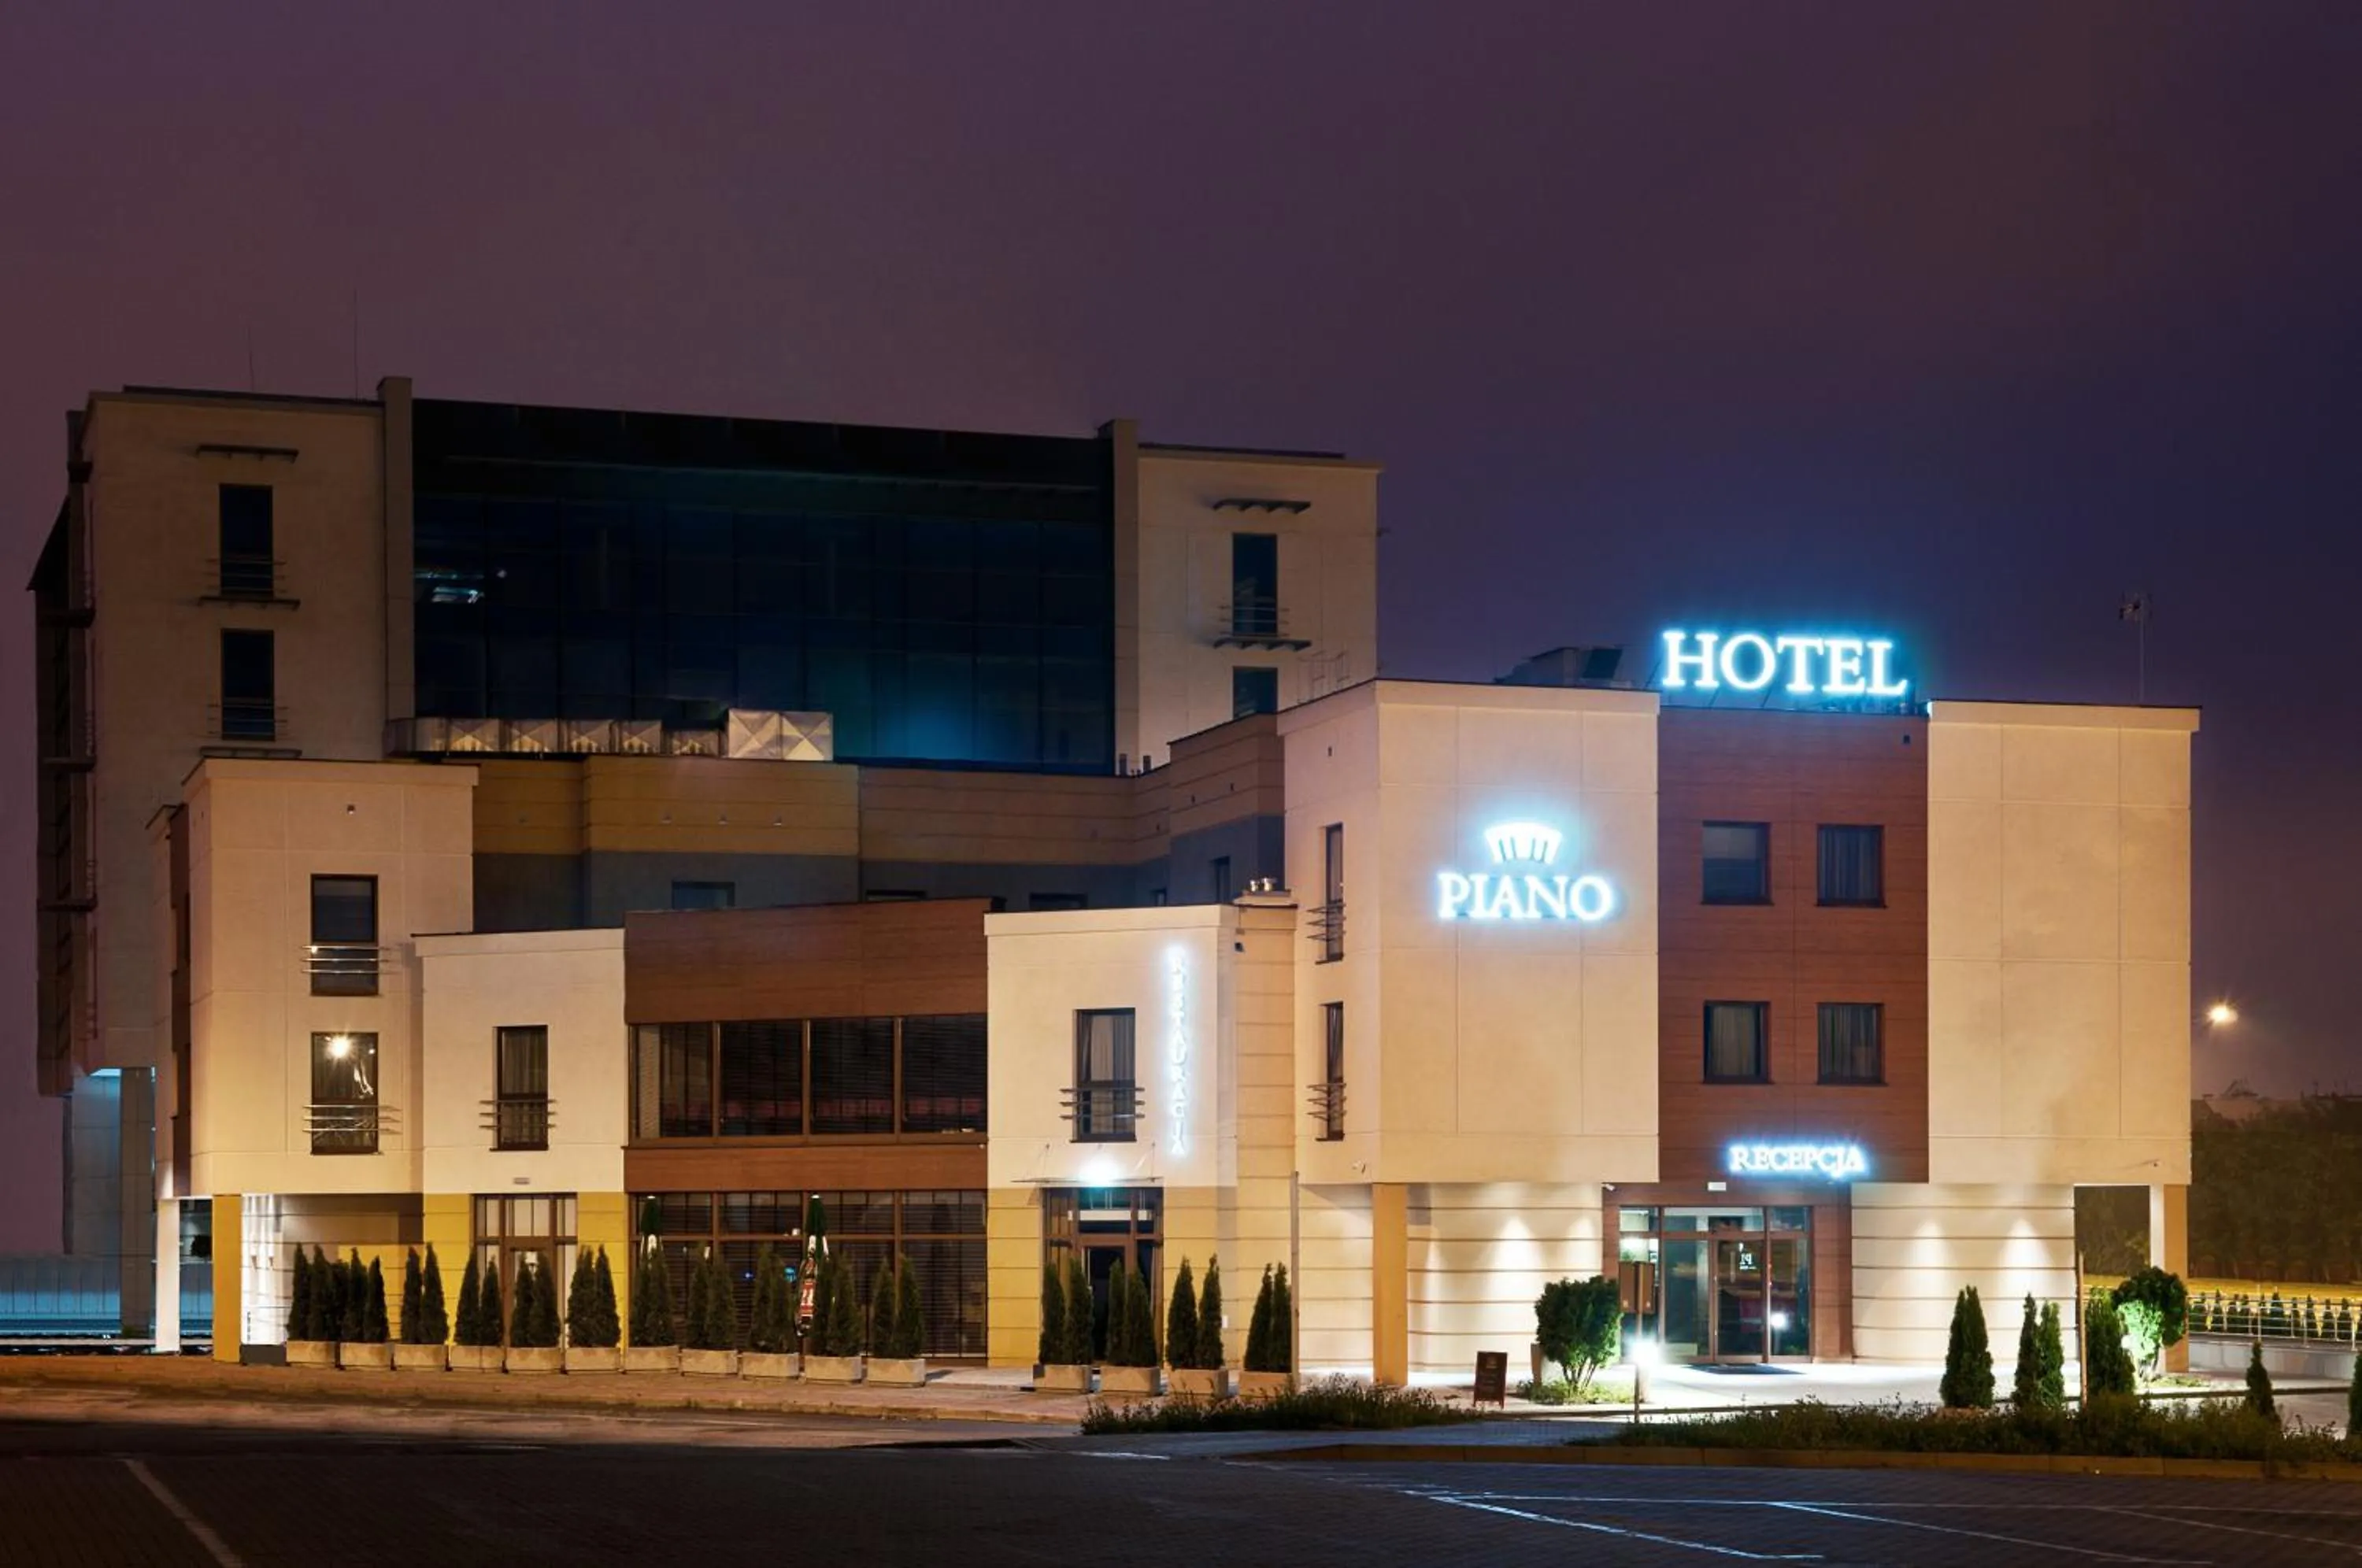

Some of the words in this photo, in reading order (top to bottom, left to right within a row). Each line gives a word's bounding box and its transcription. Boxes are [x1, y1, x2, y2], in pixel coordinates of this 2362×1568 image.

[1662, 631, 1908, 694] HOTEL
[1437, 872, 1612, 920] PIANO
[1729, 1145, 1866, 1178] RECEPCJA
